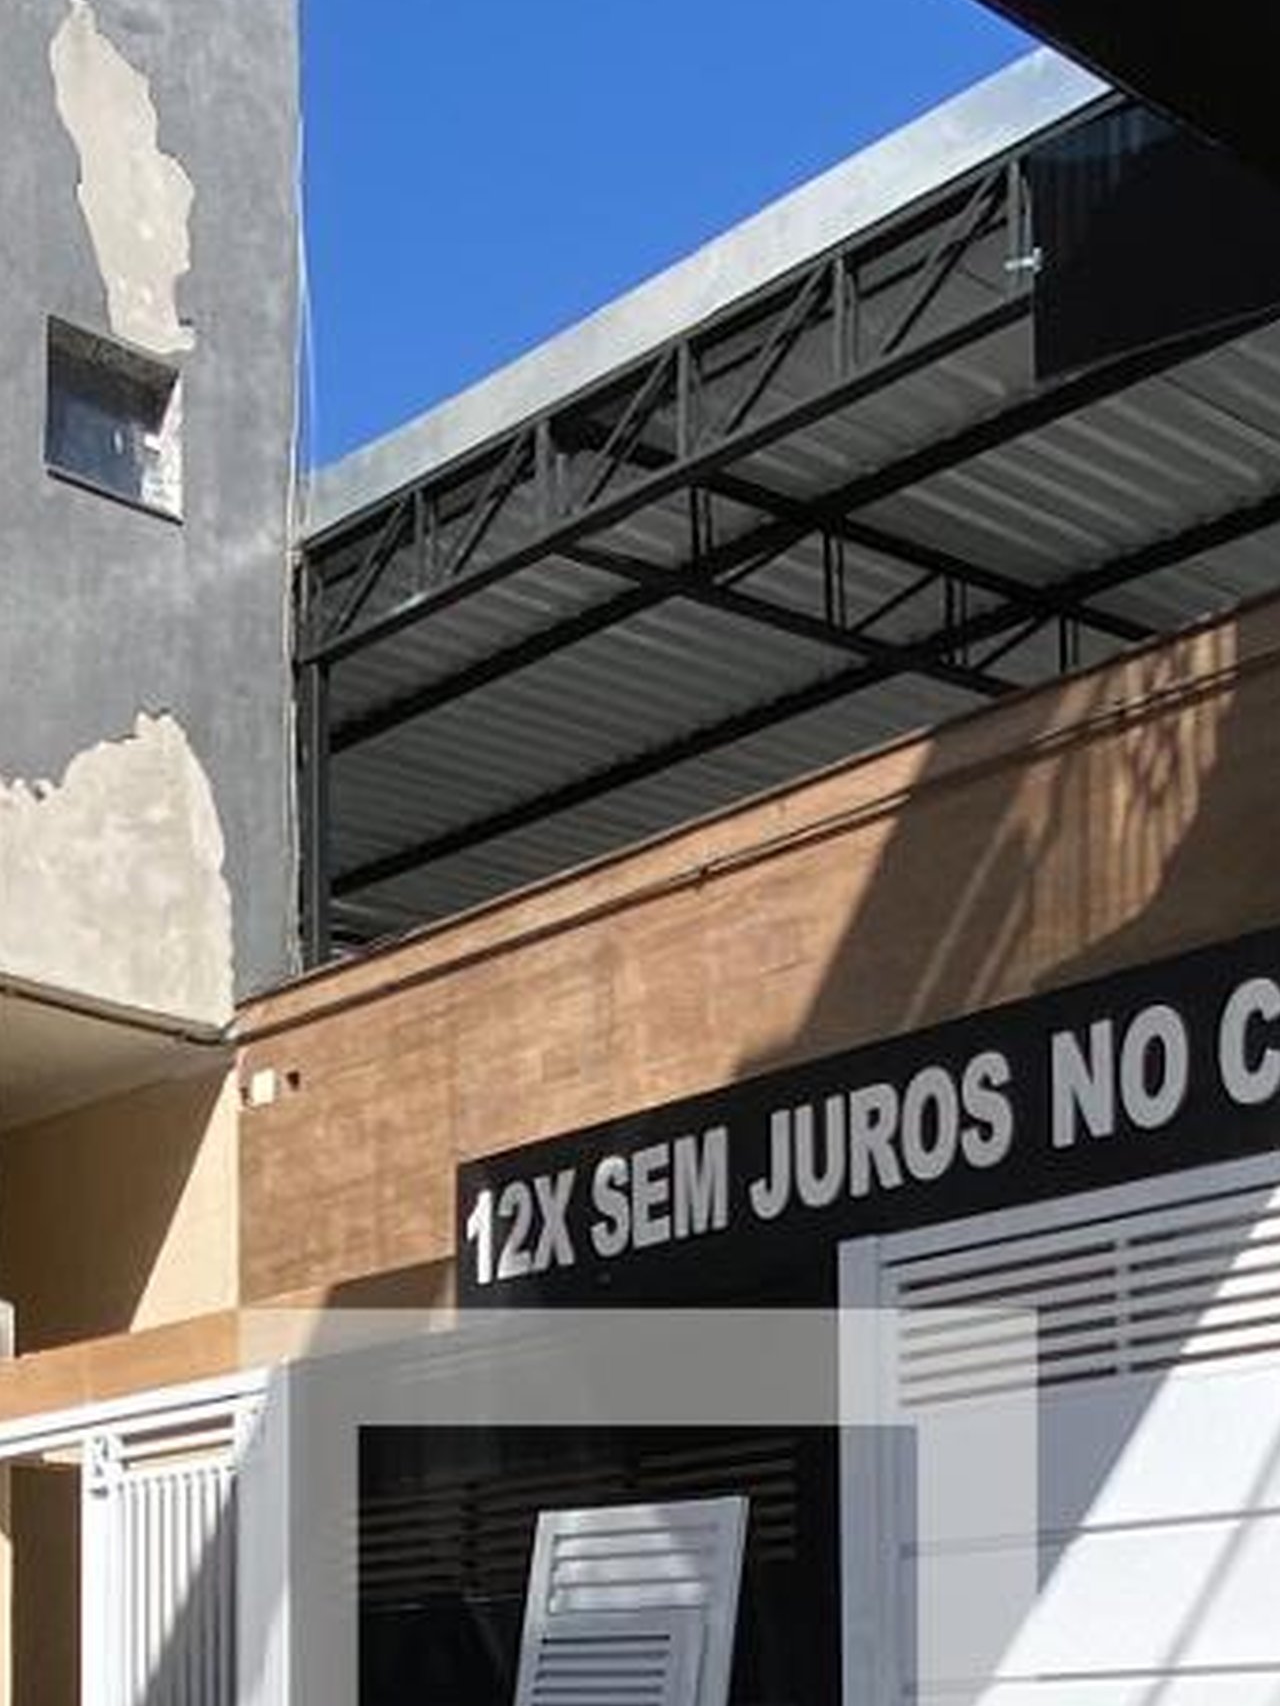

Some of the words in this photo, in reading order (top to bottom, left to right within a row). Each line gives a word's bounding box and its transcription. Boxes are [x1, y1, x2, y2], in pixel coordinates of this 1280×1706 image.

[466, 1164, 575, 1284] 12X
[590, 1126, 729, 1259] SEM
[749, 1050, 1014, 1220] JUROS
[1050, 1003, 1189, 1149] NO
